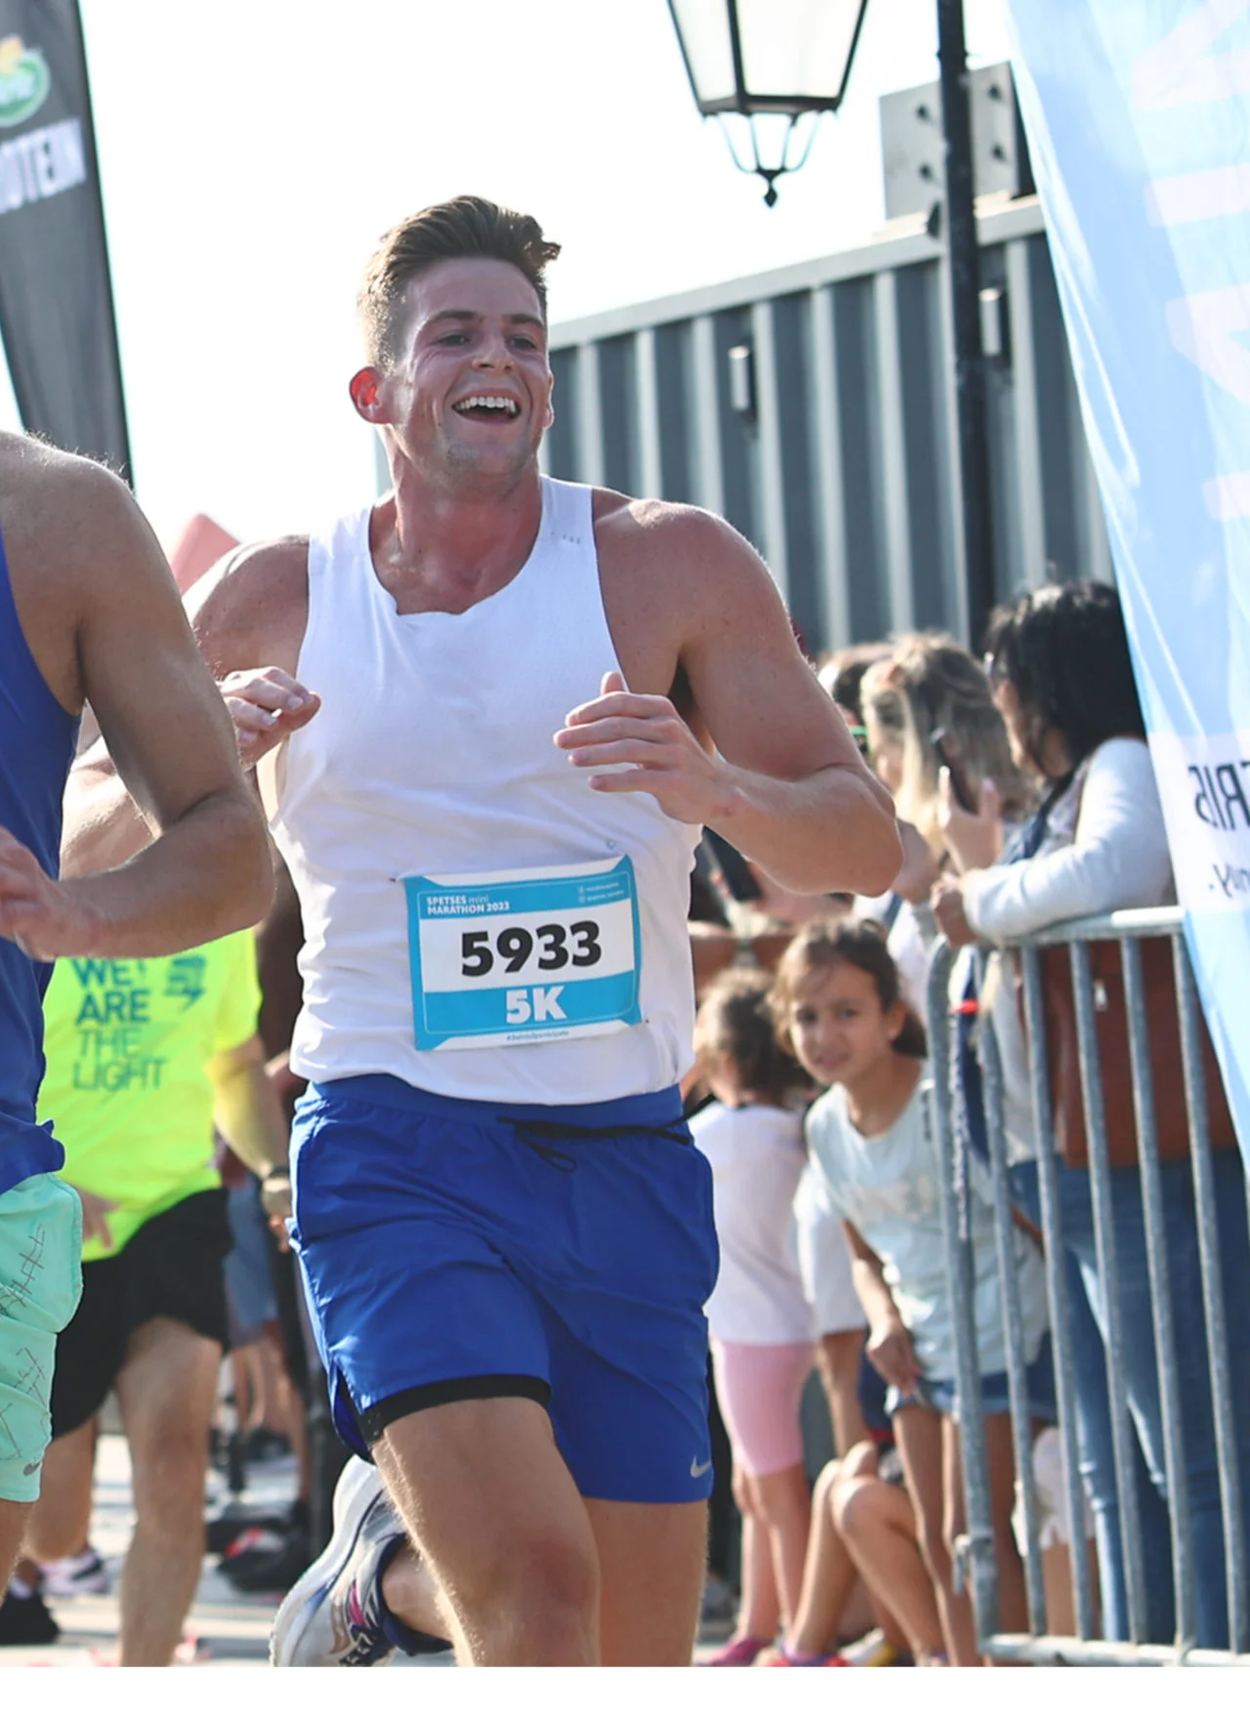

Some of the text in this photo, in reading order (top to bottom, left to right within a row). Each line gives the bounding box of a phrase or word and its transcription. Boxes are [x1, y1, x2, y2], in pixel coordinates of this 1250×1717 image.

[426, 895, 467, 906] SPETSES
[427, 901, 510, 915] MARATHON 2023
[461, 920, 602, 977] 5933
[75, 989, 151, 1025] ARE
[506, 985, 567, 1025] 5K
[78, 1028, 143, 1059] THE
[72, 1057, 167, 1092] LIGHT
